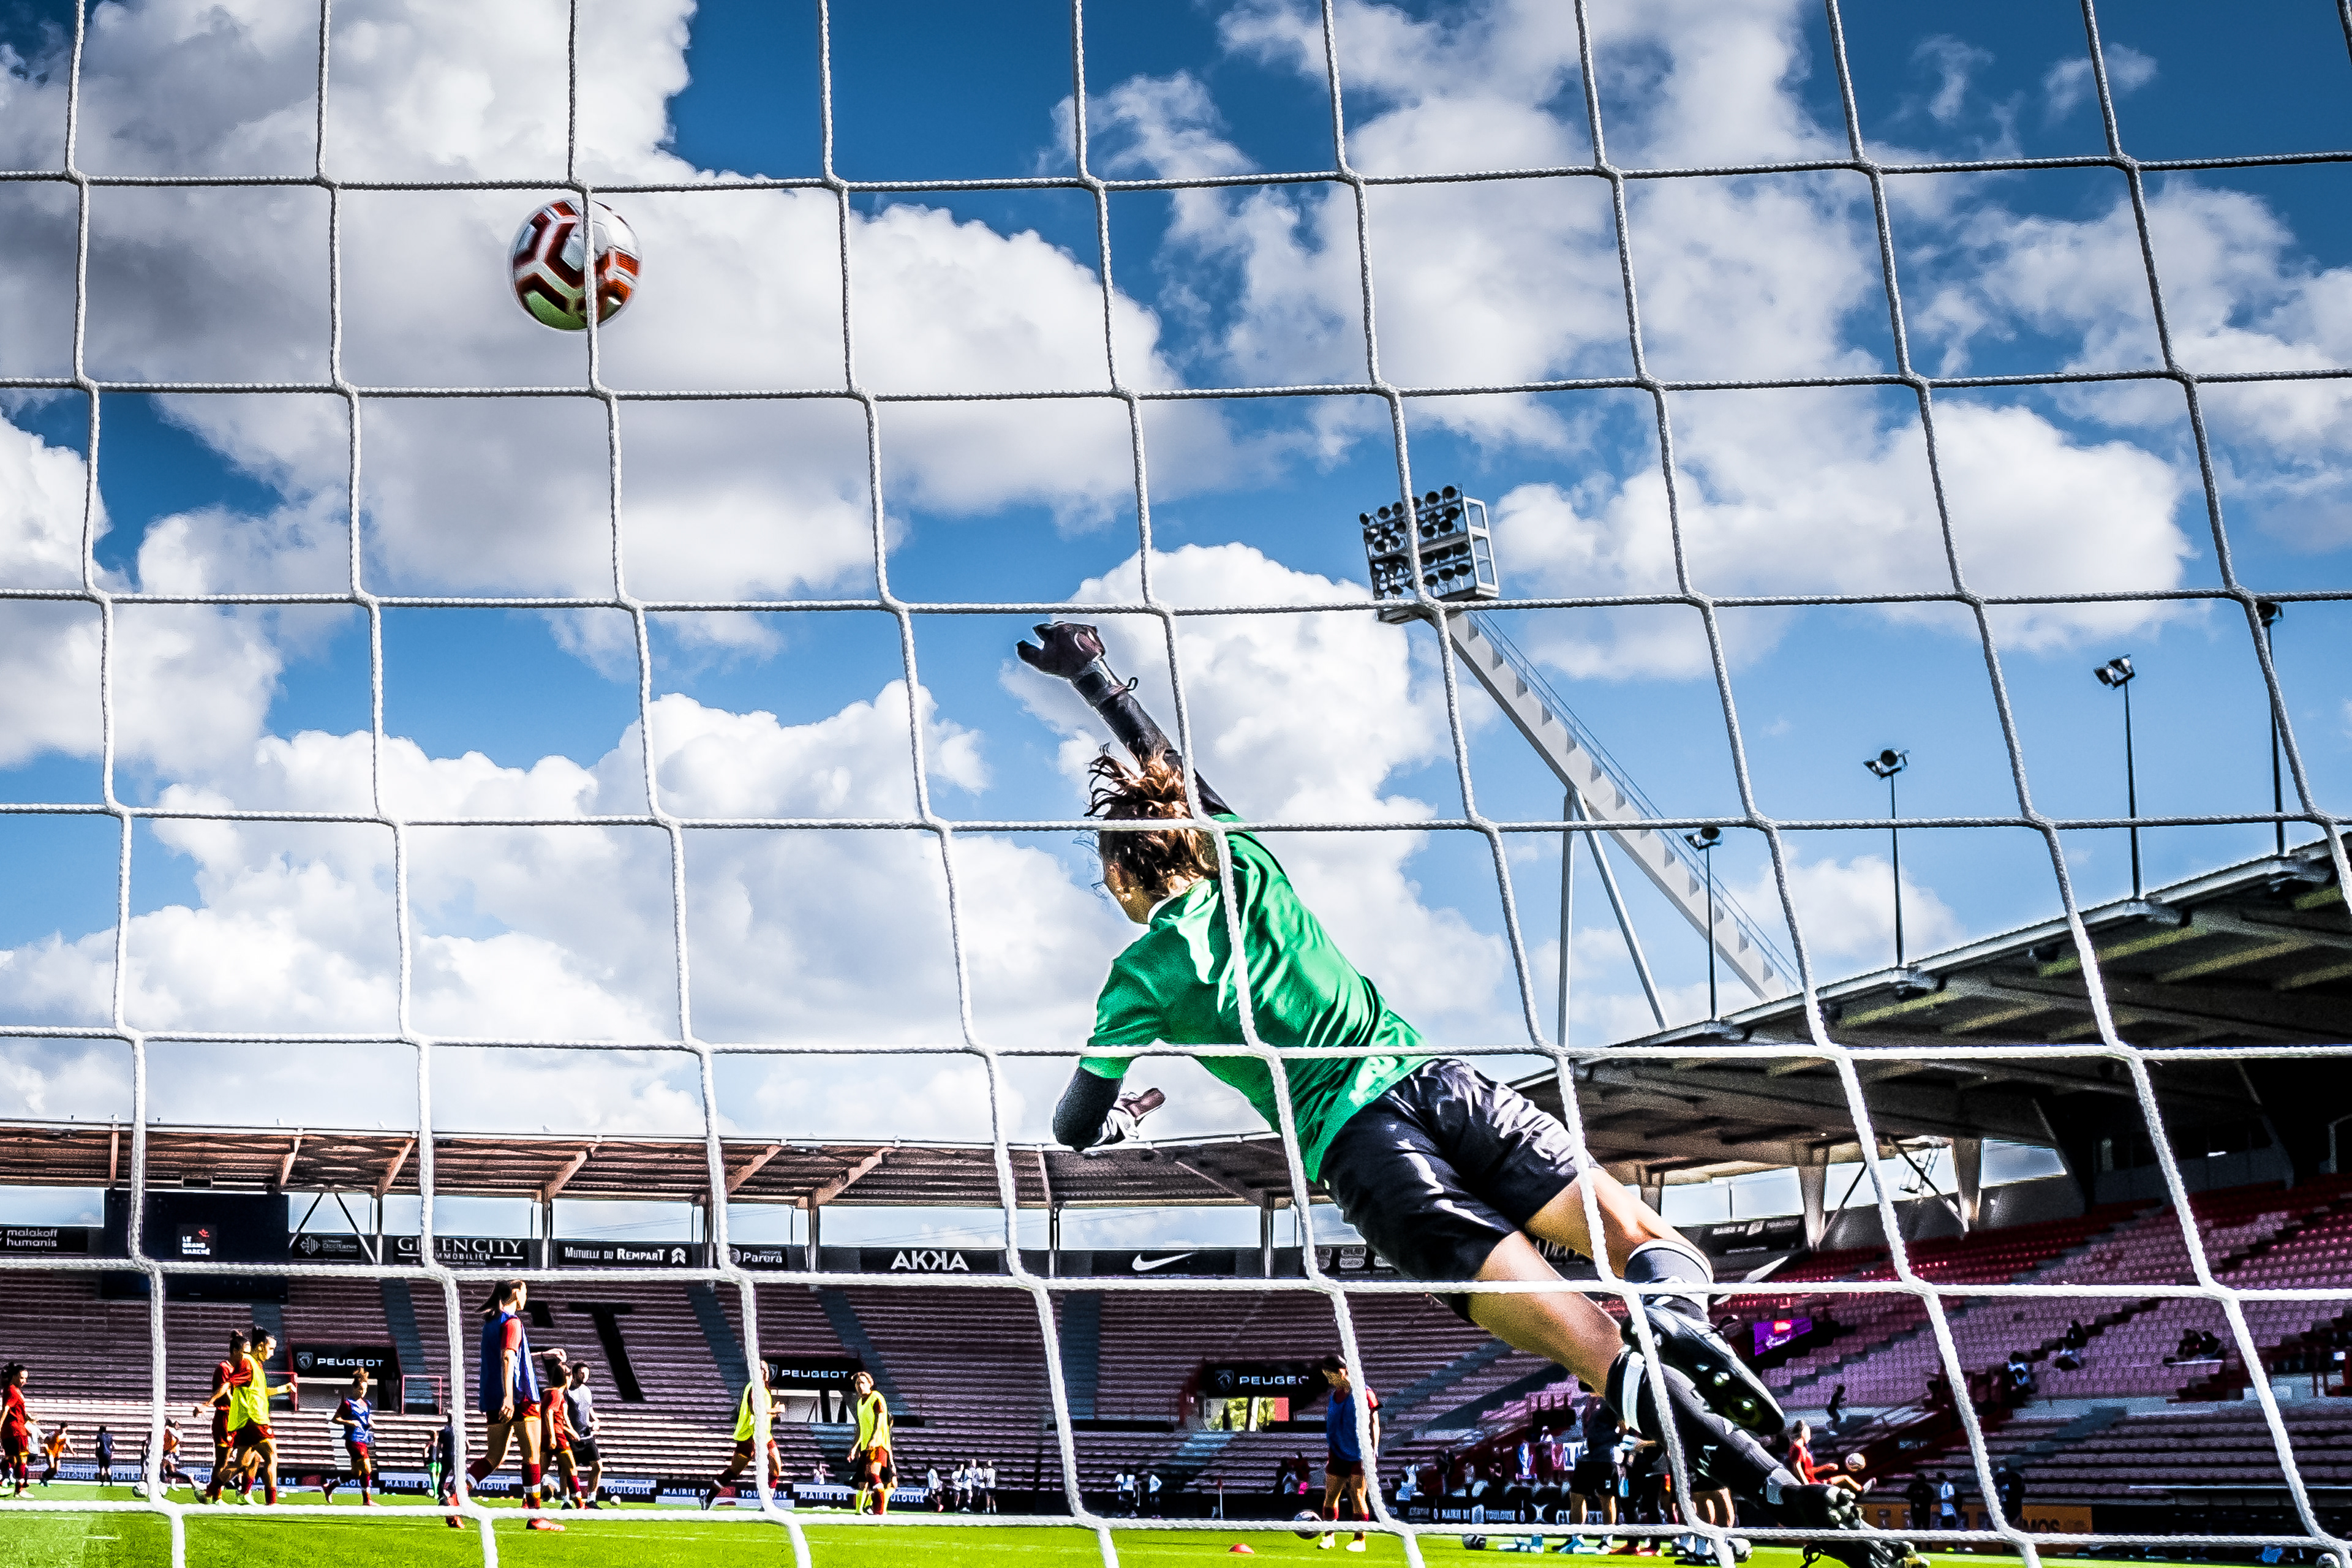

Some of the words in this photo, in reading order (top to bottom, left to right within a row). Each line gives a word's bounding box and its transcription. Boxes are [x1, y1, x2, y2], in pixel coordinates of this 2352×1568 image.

[7, 1228, 58, 1237] malakoff
[7, 1237, 58, 1247] humanis
[398, 1237, 522, 1254] GENCITY
[890, 1250, 970, 1272] AKKA
[317, 1358, 384, 1367] PEUGEOT
[782, 1370, 848, 1379] PEUGEOT
[1239, 1376, 1310, 1385] PEUGE
[385, 1479, 418, 1488] MAIRIE
[604, 1486, 650, 1495] TOULOUSE
